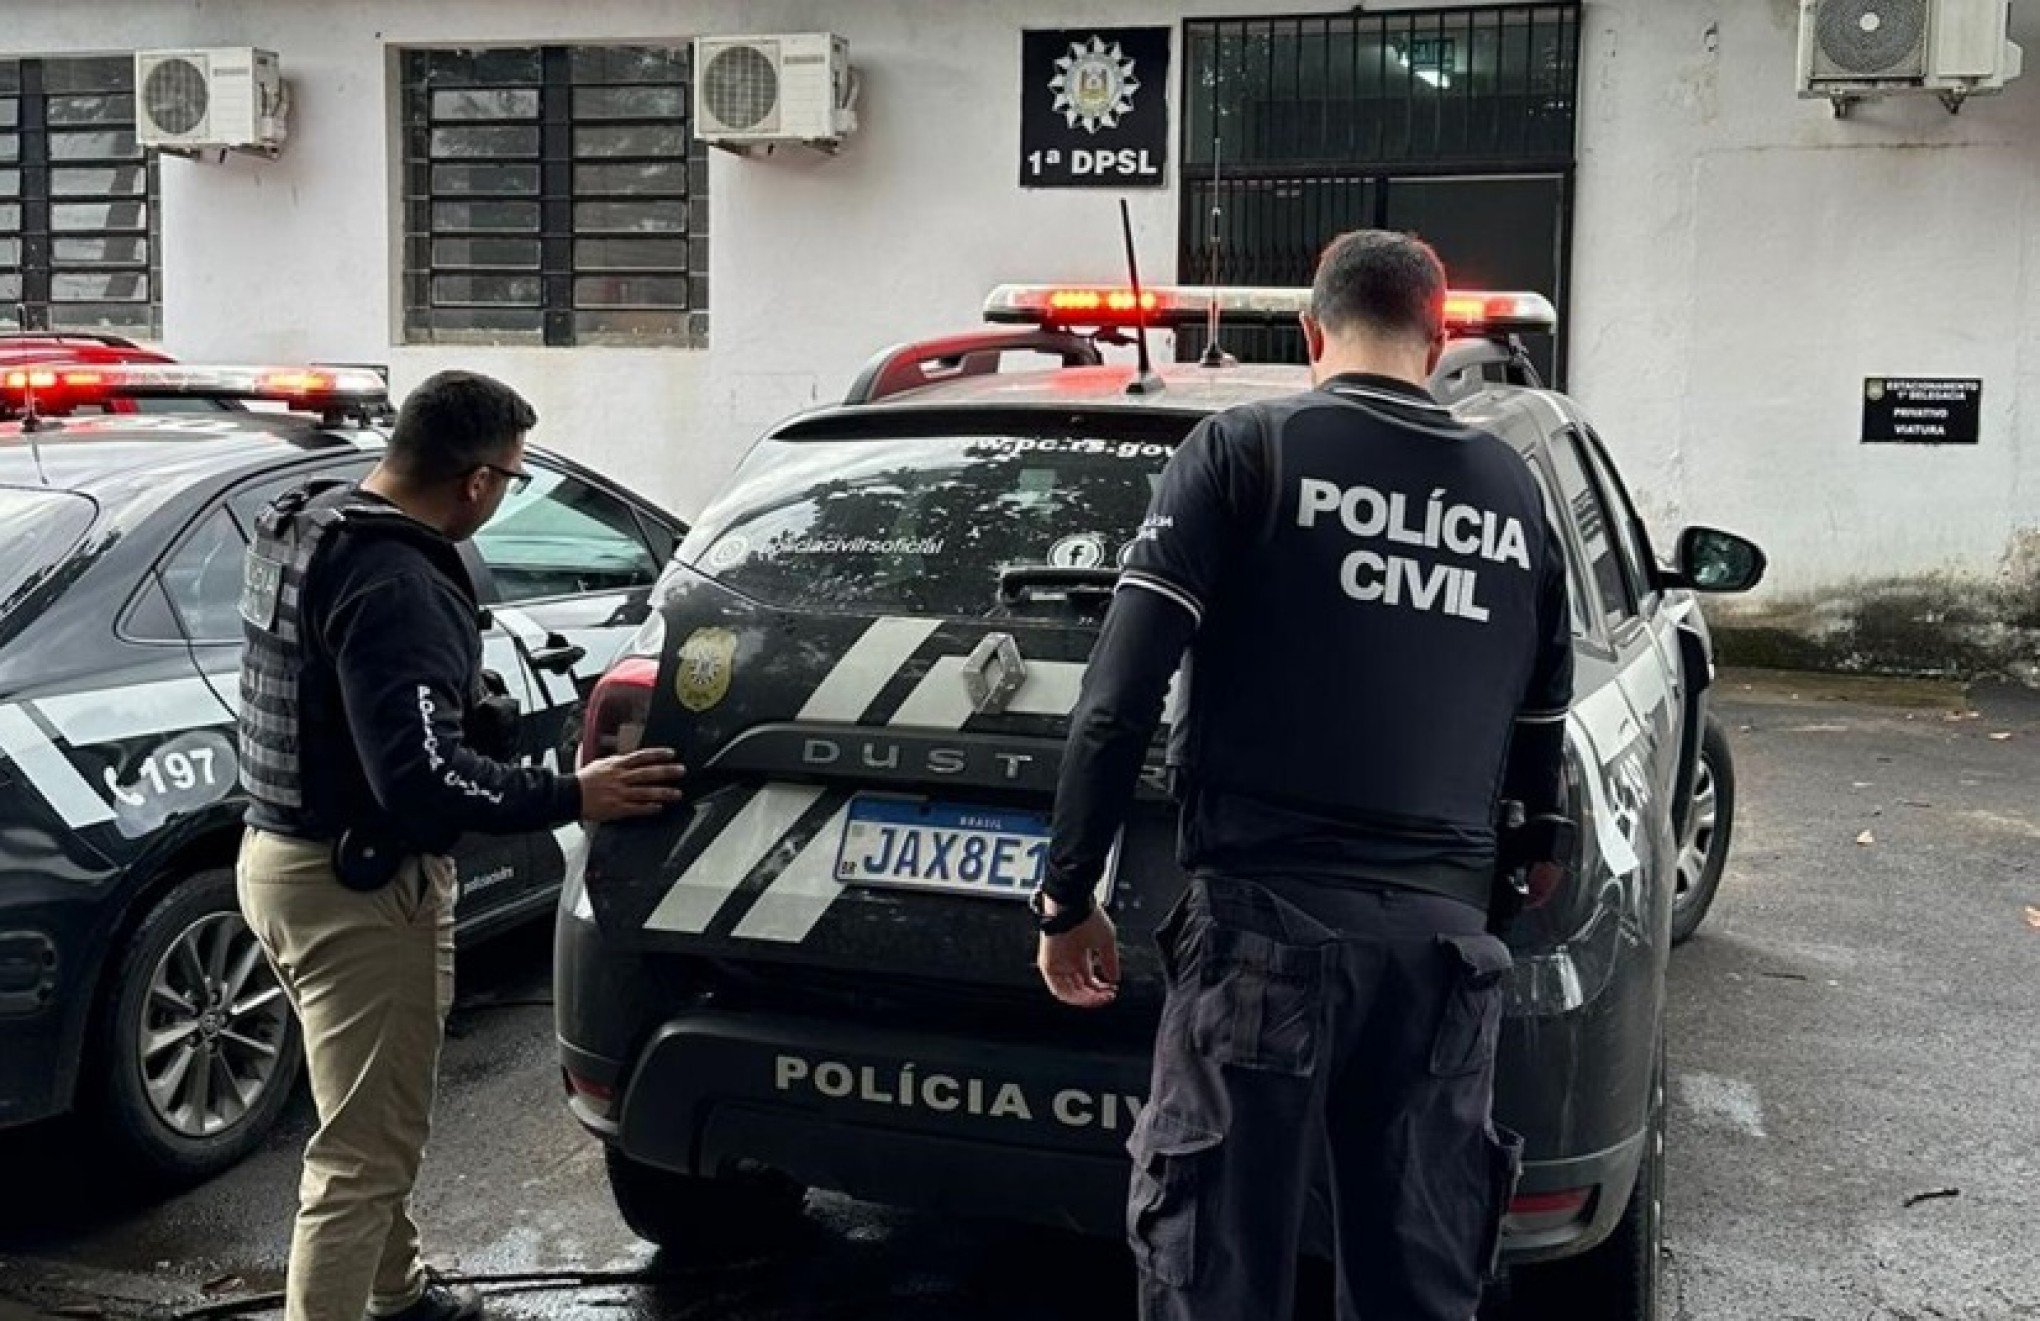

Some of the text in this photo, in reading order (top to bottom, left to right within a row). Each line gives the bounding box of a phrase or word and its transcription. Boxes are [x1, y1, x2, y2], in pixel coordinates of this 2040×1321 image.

[1071, 148, 1158, 175] DPSL
[1297, 476, 1531, 570] POLÍCIA
[1340, 550, 1490, 622] CIVIL
[138, 747, 216, 794] 197
[864, 826, 1051, 889] JAX8E1
[775, 1054, 1033, 1120] POLÍCIA
